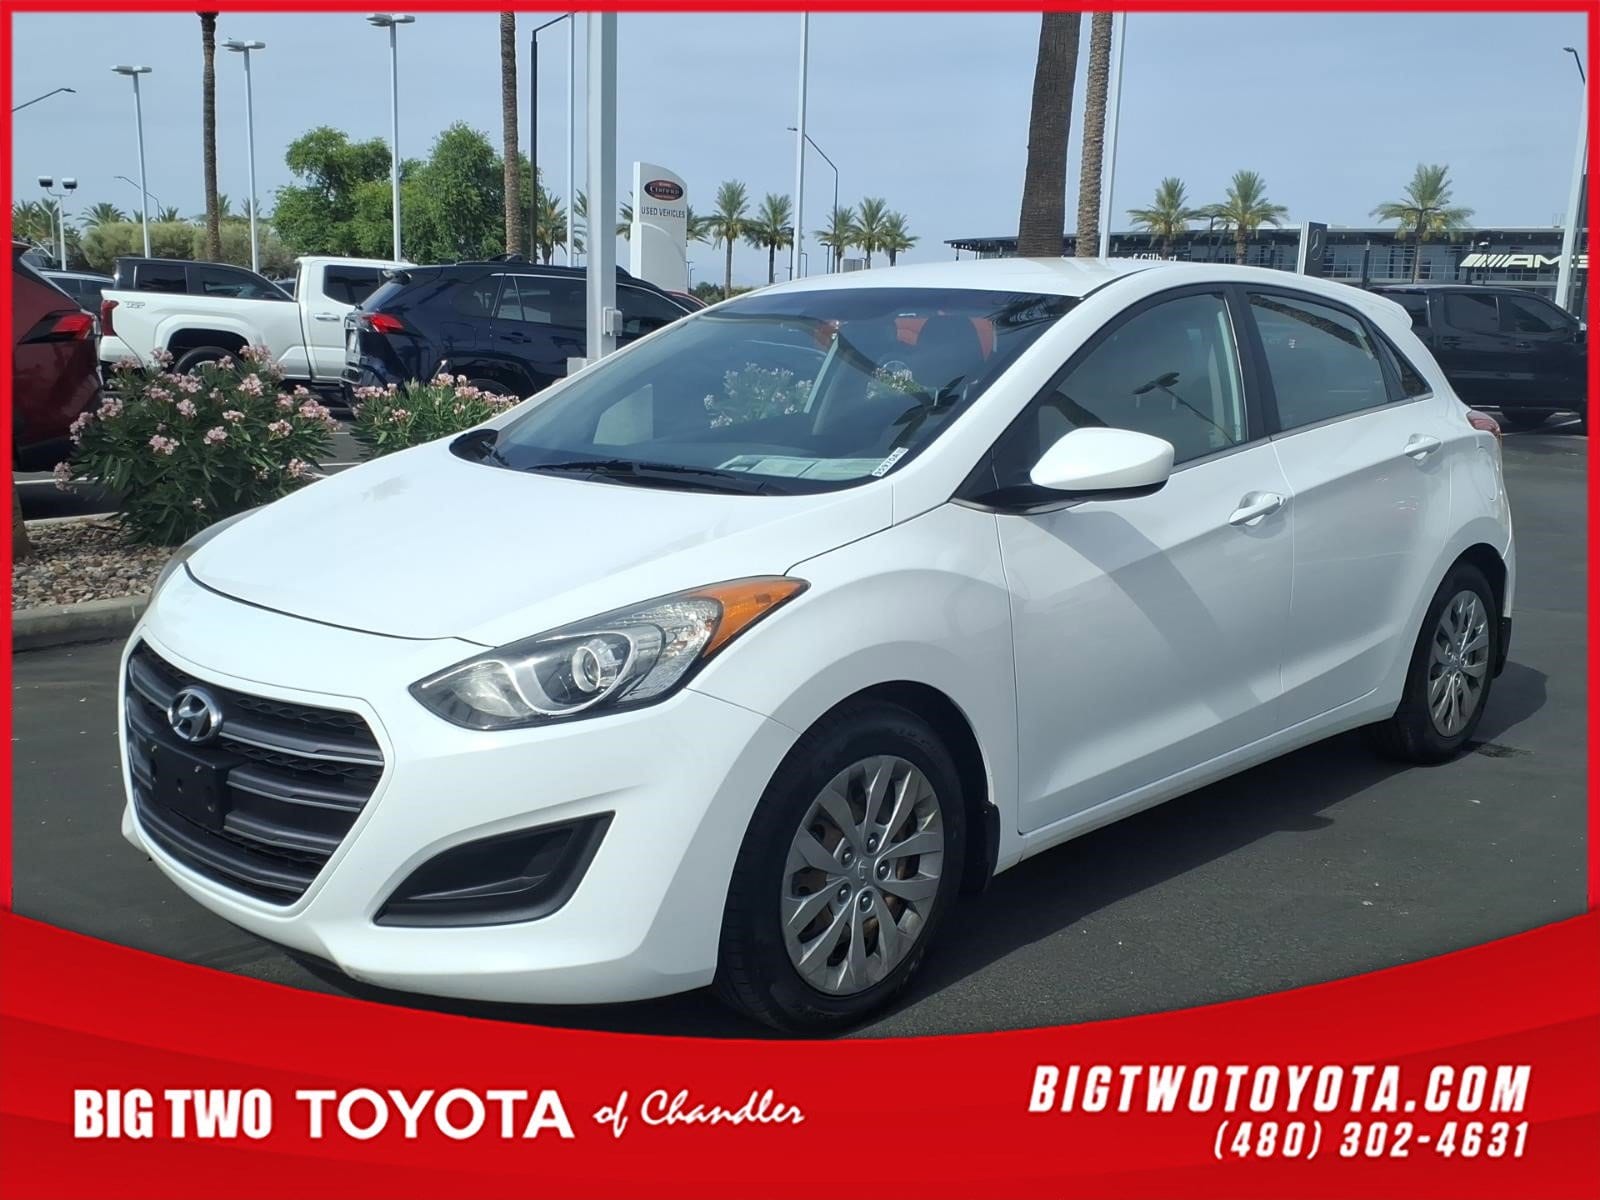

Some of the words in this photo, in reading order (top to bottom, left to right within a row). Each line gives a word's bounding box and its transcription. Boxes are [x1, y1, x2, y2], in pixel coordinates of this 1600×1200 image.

[641, 206, 658, 216] USED
[659, 207, 686, 219] VEHICLES
[1140, 253, 1178, 262] Gilbrt
